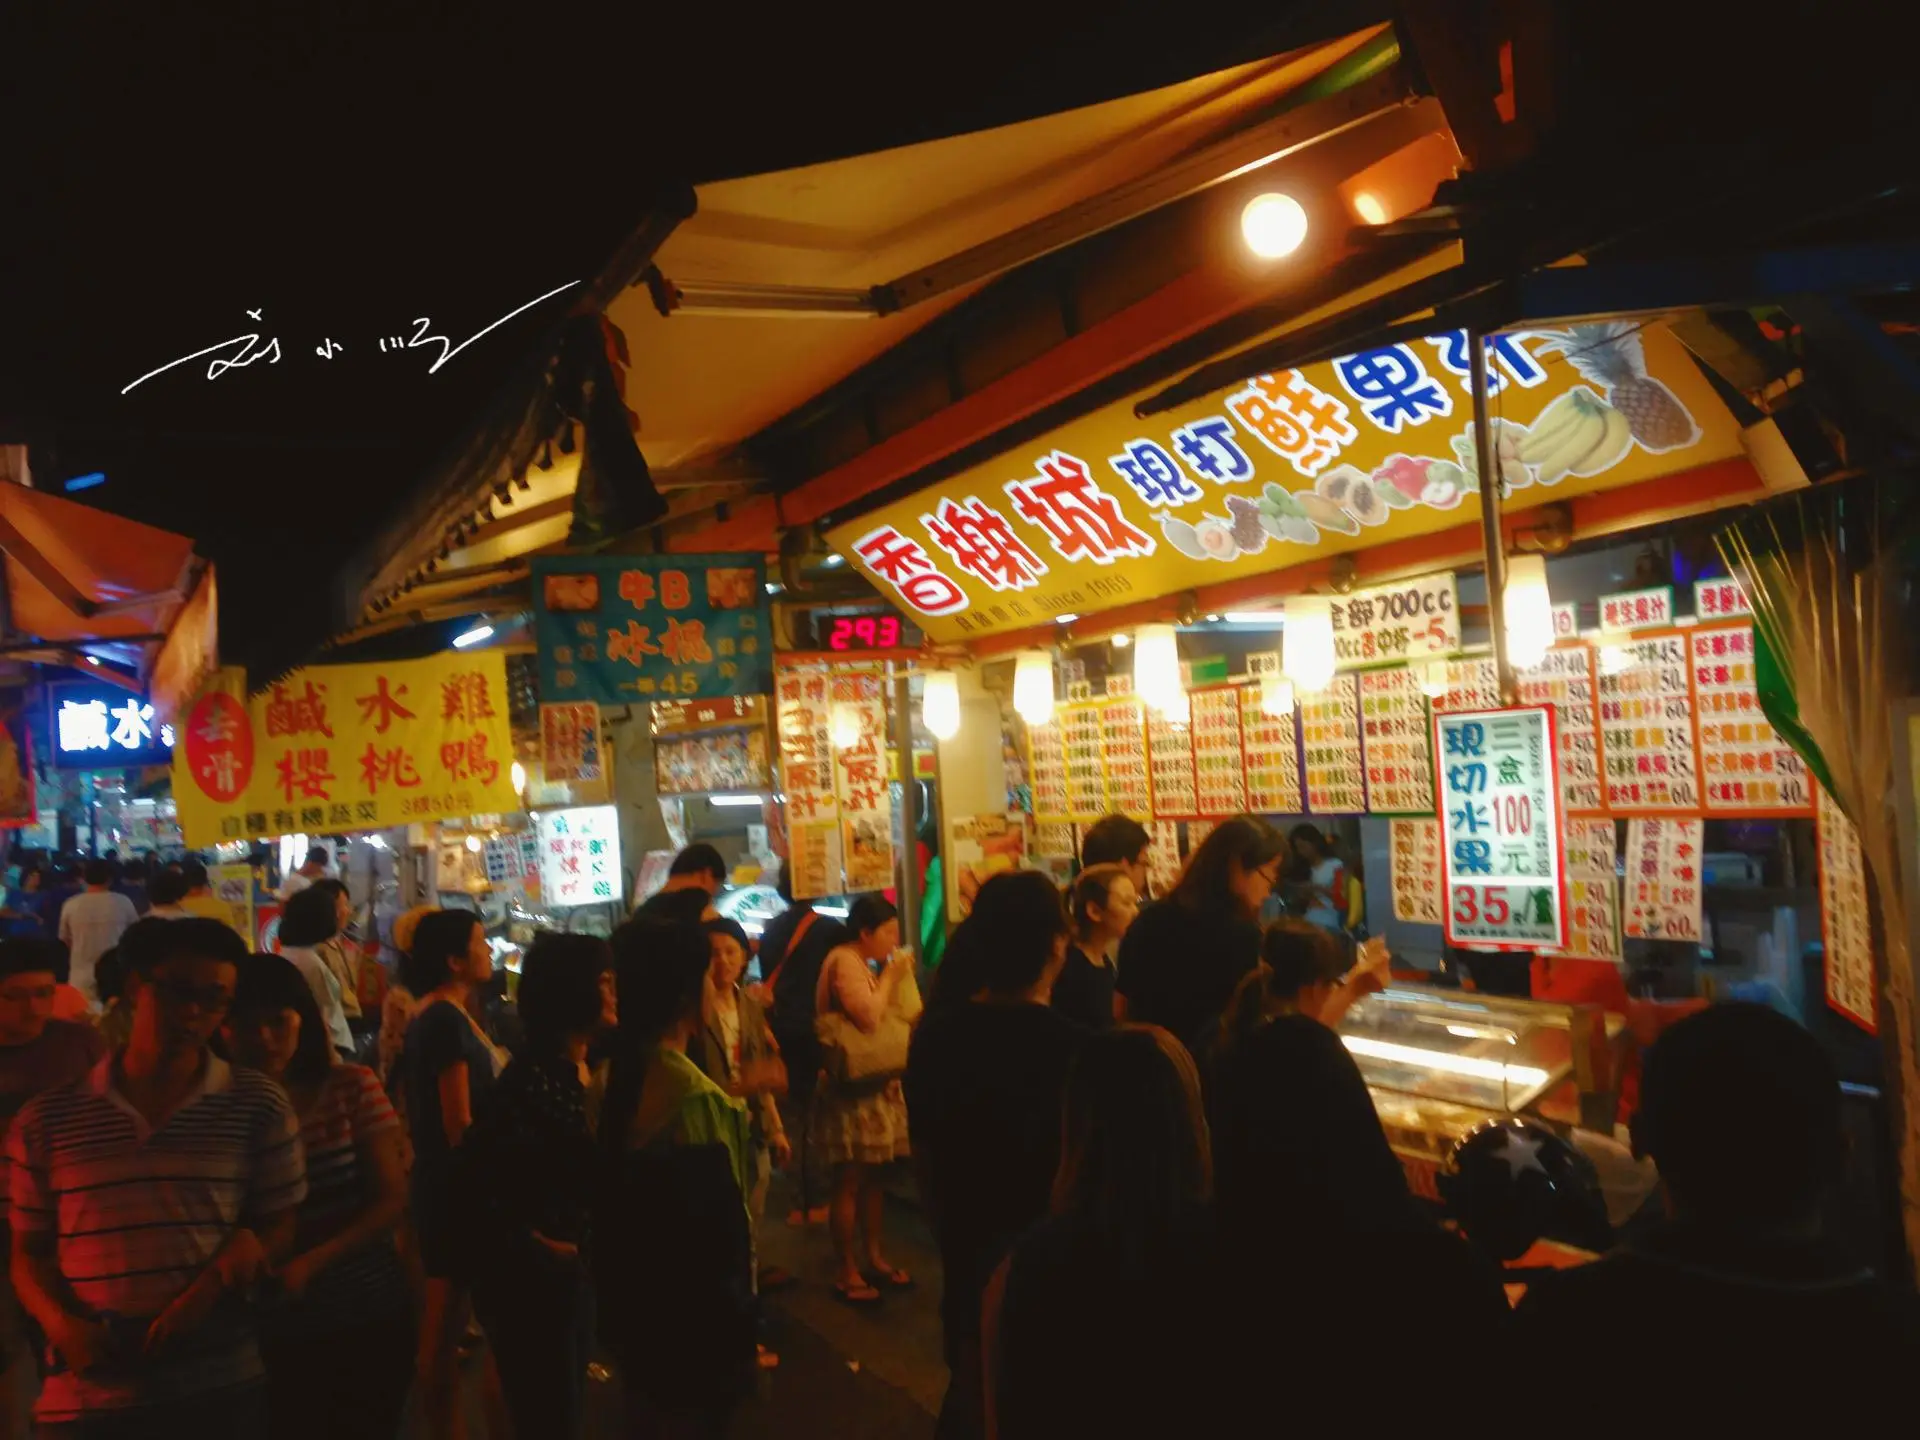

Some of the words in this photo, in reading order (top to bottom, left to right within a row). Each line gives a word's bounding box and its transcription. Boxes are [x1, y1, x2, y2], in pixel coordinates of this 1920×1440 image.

[1033, 590, 1085, 611] Since
[1085, 575, 1133, 599] 1969
[830, 616, 899, 651] 293
[265, 672, 496, 739] 鹹水雞
[195, 700, 243, 793] 去骨
[275, 731, 499, 804] 櫻桃鴨
[1445, 722, 1493, 875] 現切水果
